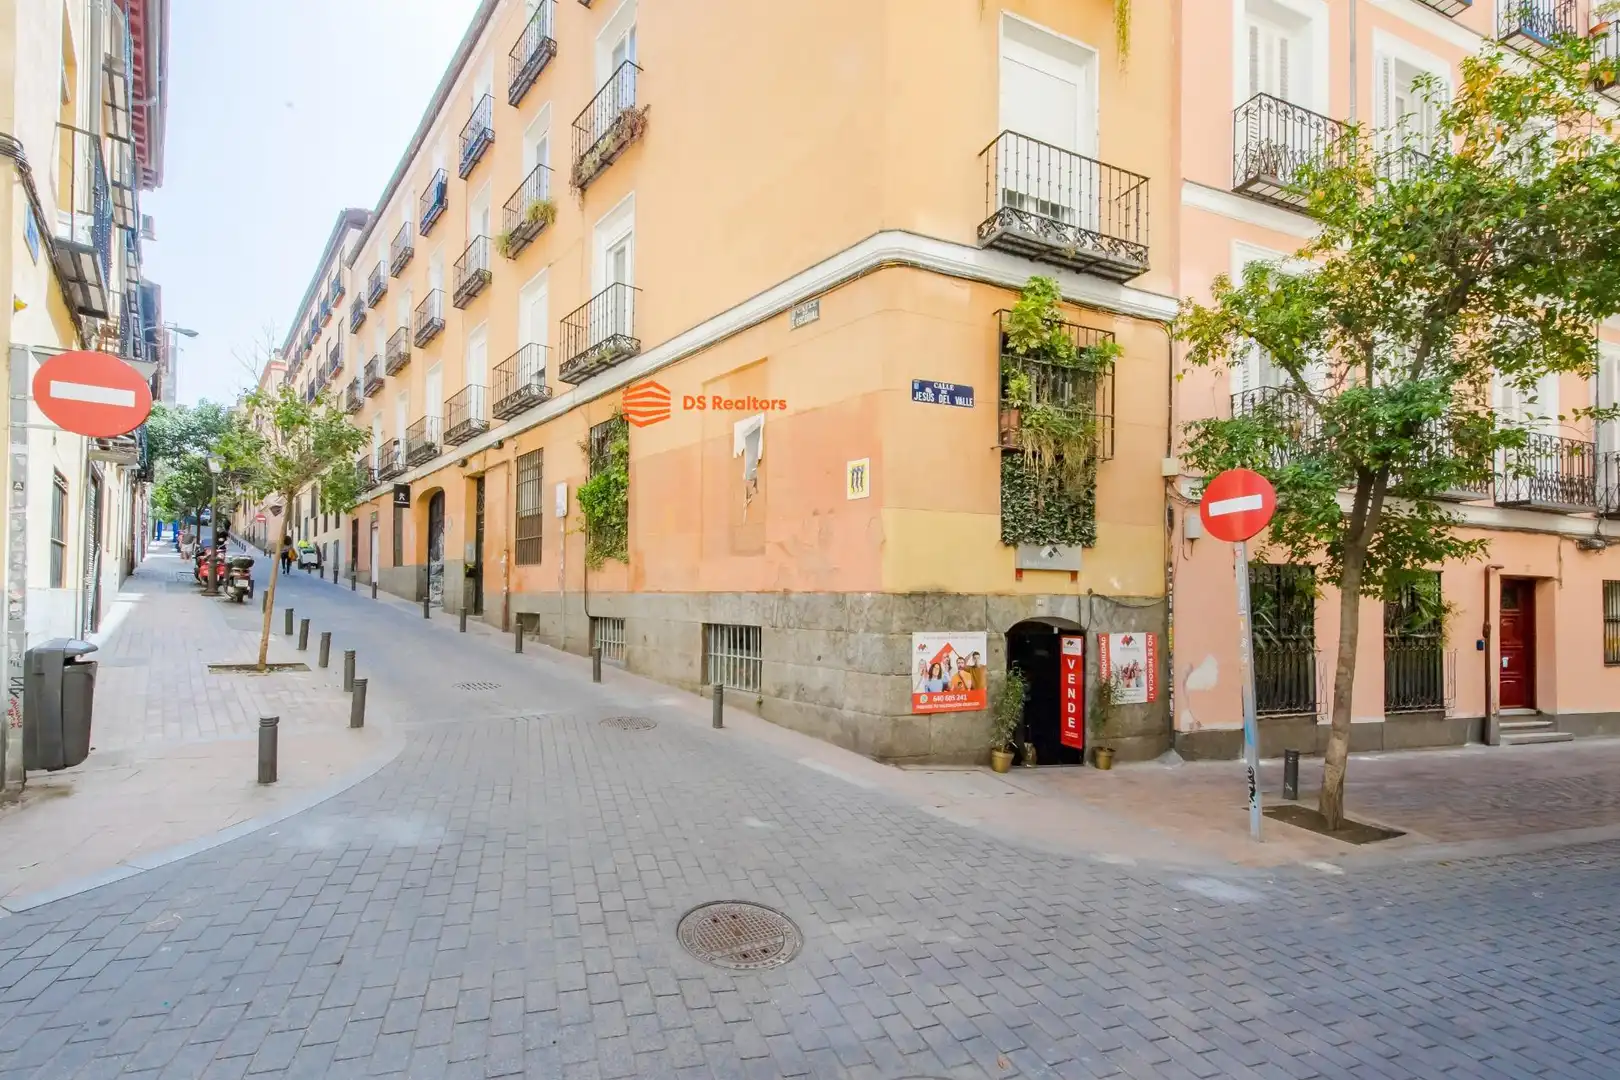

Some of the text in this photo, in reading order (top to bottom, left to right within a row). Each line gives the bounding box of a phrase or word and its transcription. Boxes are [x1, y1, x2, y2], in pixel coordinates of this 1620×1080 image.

[933, 382, 955, 391] CALLE
[938, 394, 951, 404] DEL
[955, 396, 973, 407] VALLE
[1147, 635, 1153, 646] NO
[1147, 648, 1153, 656] SE
[956, 693, 967, 701] 241
[1067, 658, 1076, 728] VENDE
